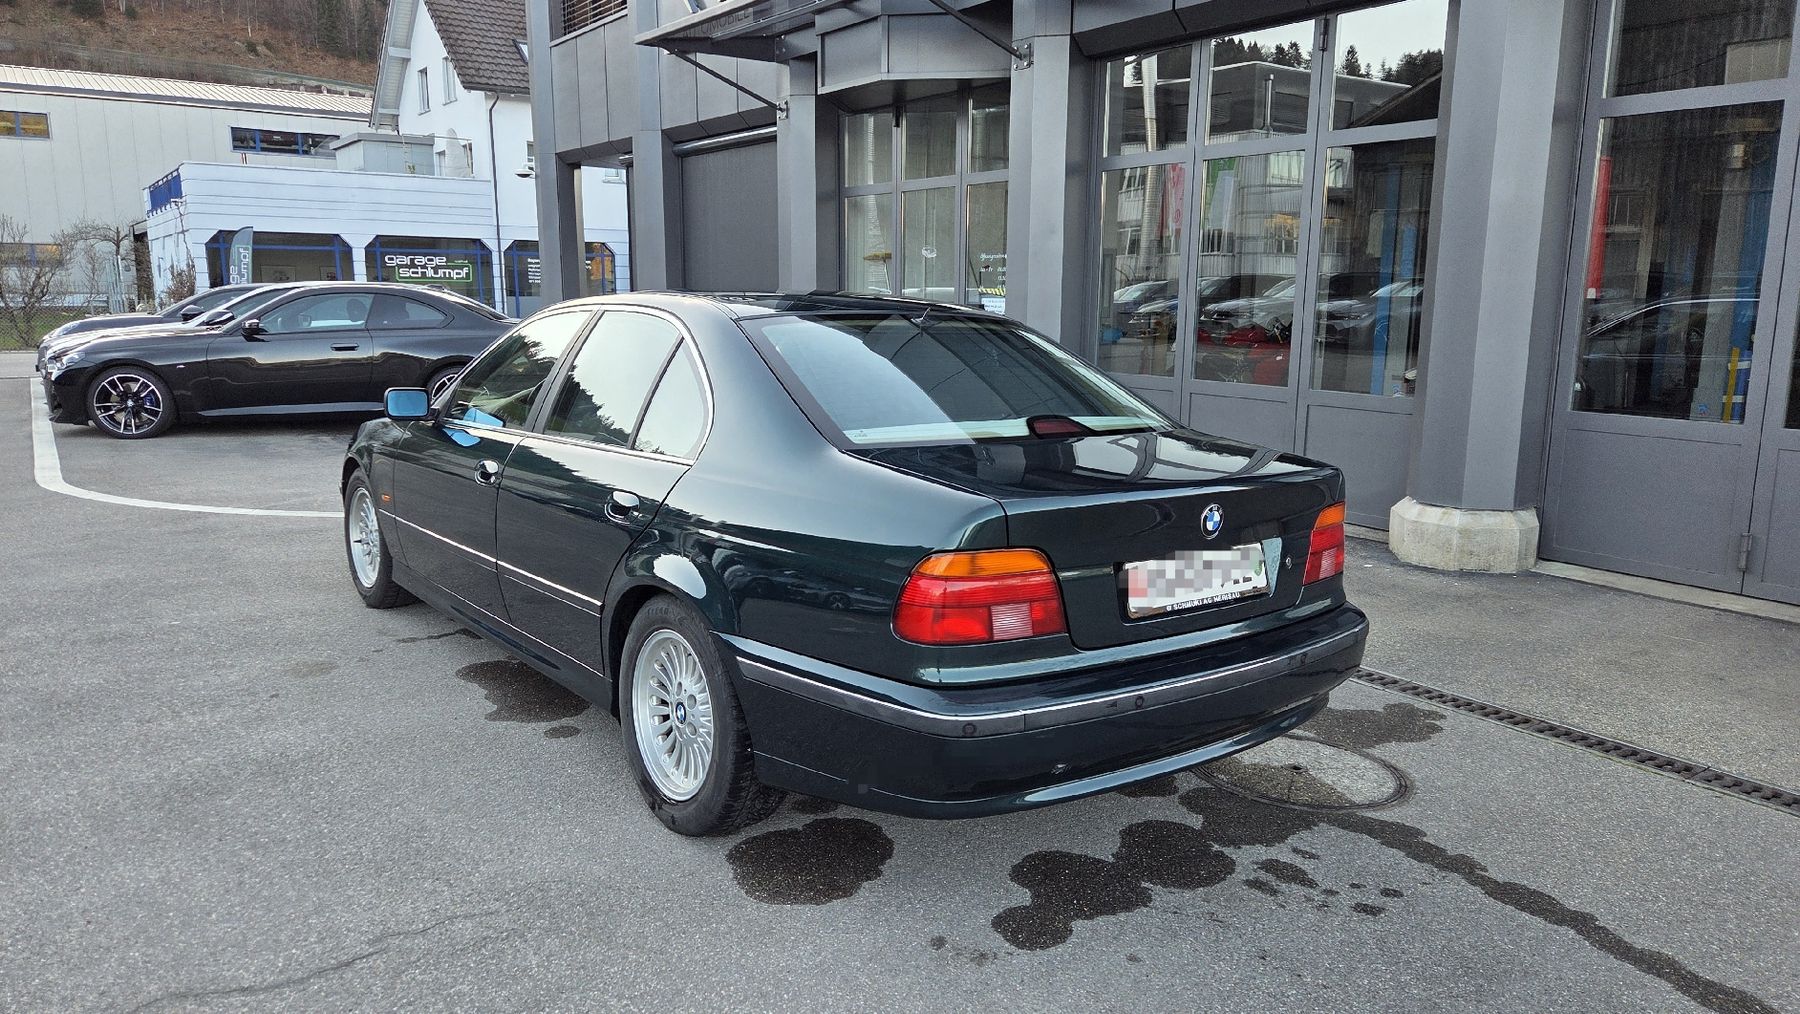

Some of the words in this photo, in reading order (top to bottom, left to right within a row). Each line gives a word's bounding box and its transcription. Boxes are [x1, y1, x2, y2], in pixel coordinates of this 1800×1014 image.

[239, 247, 249, 284] lumpf
[385, 255, 446, 267] garage
[399, 266, 469, 280] schlumpf
